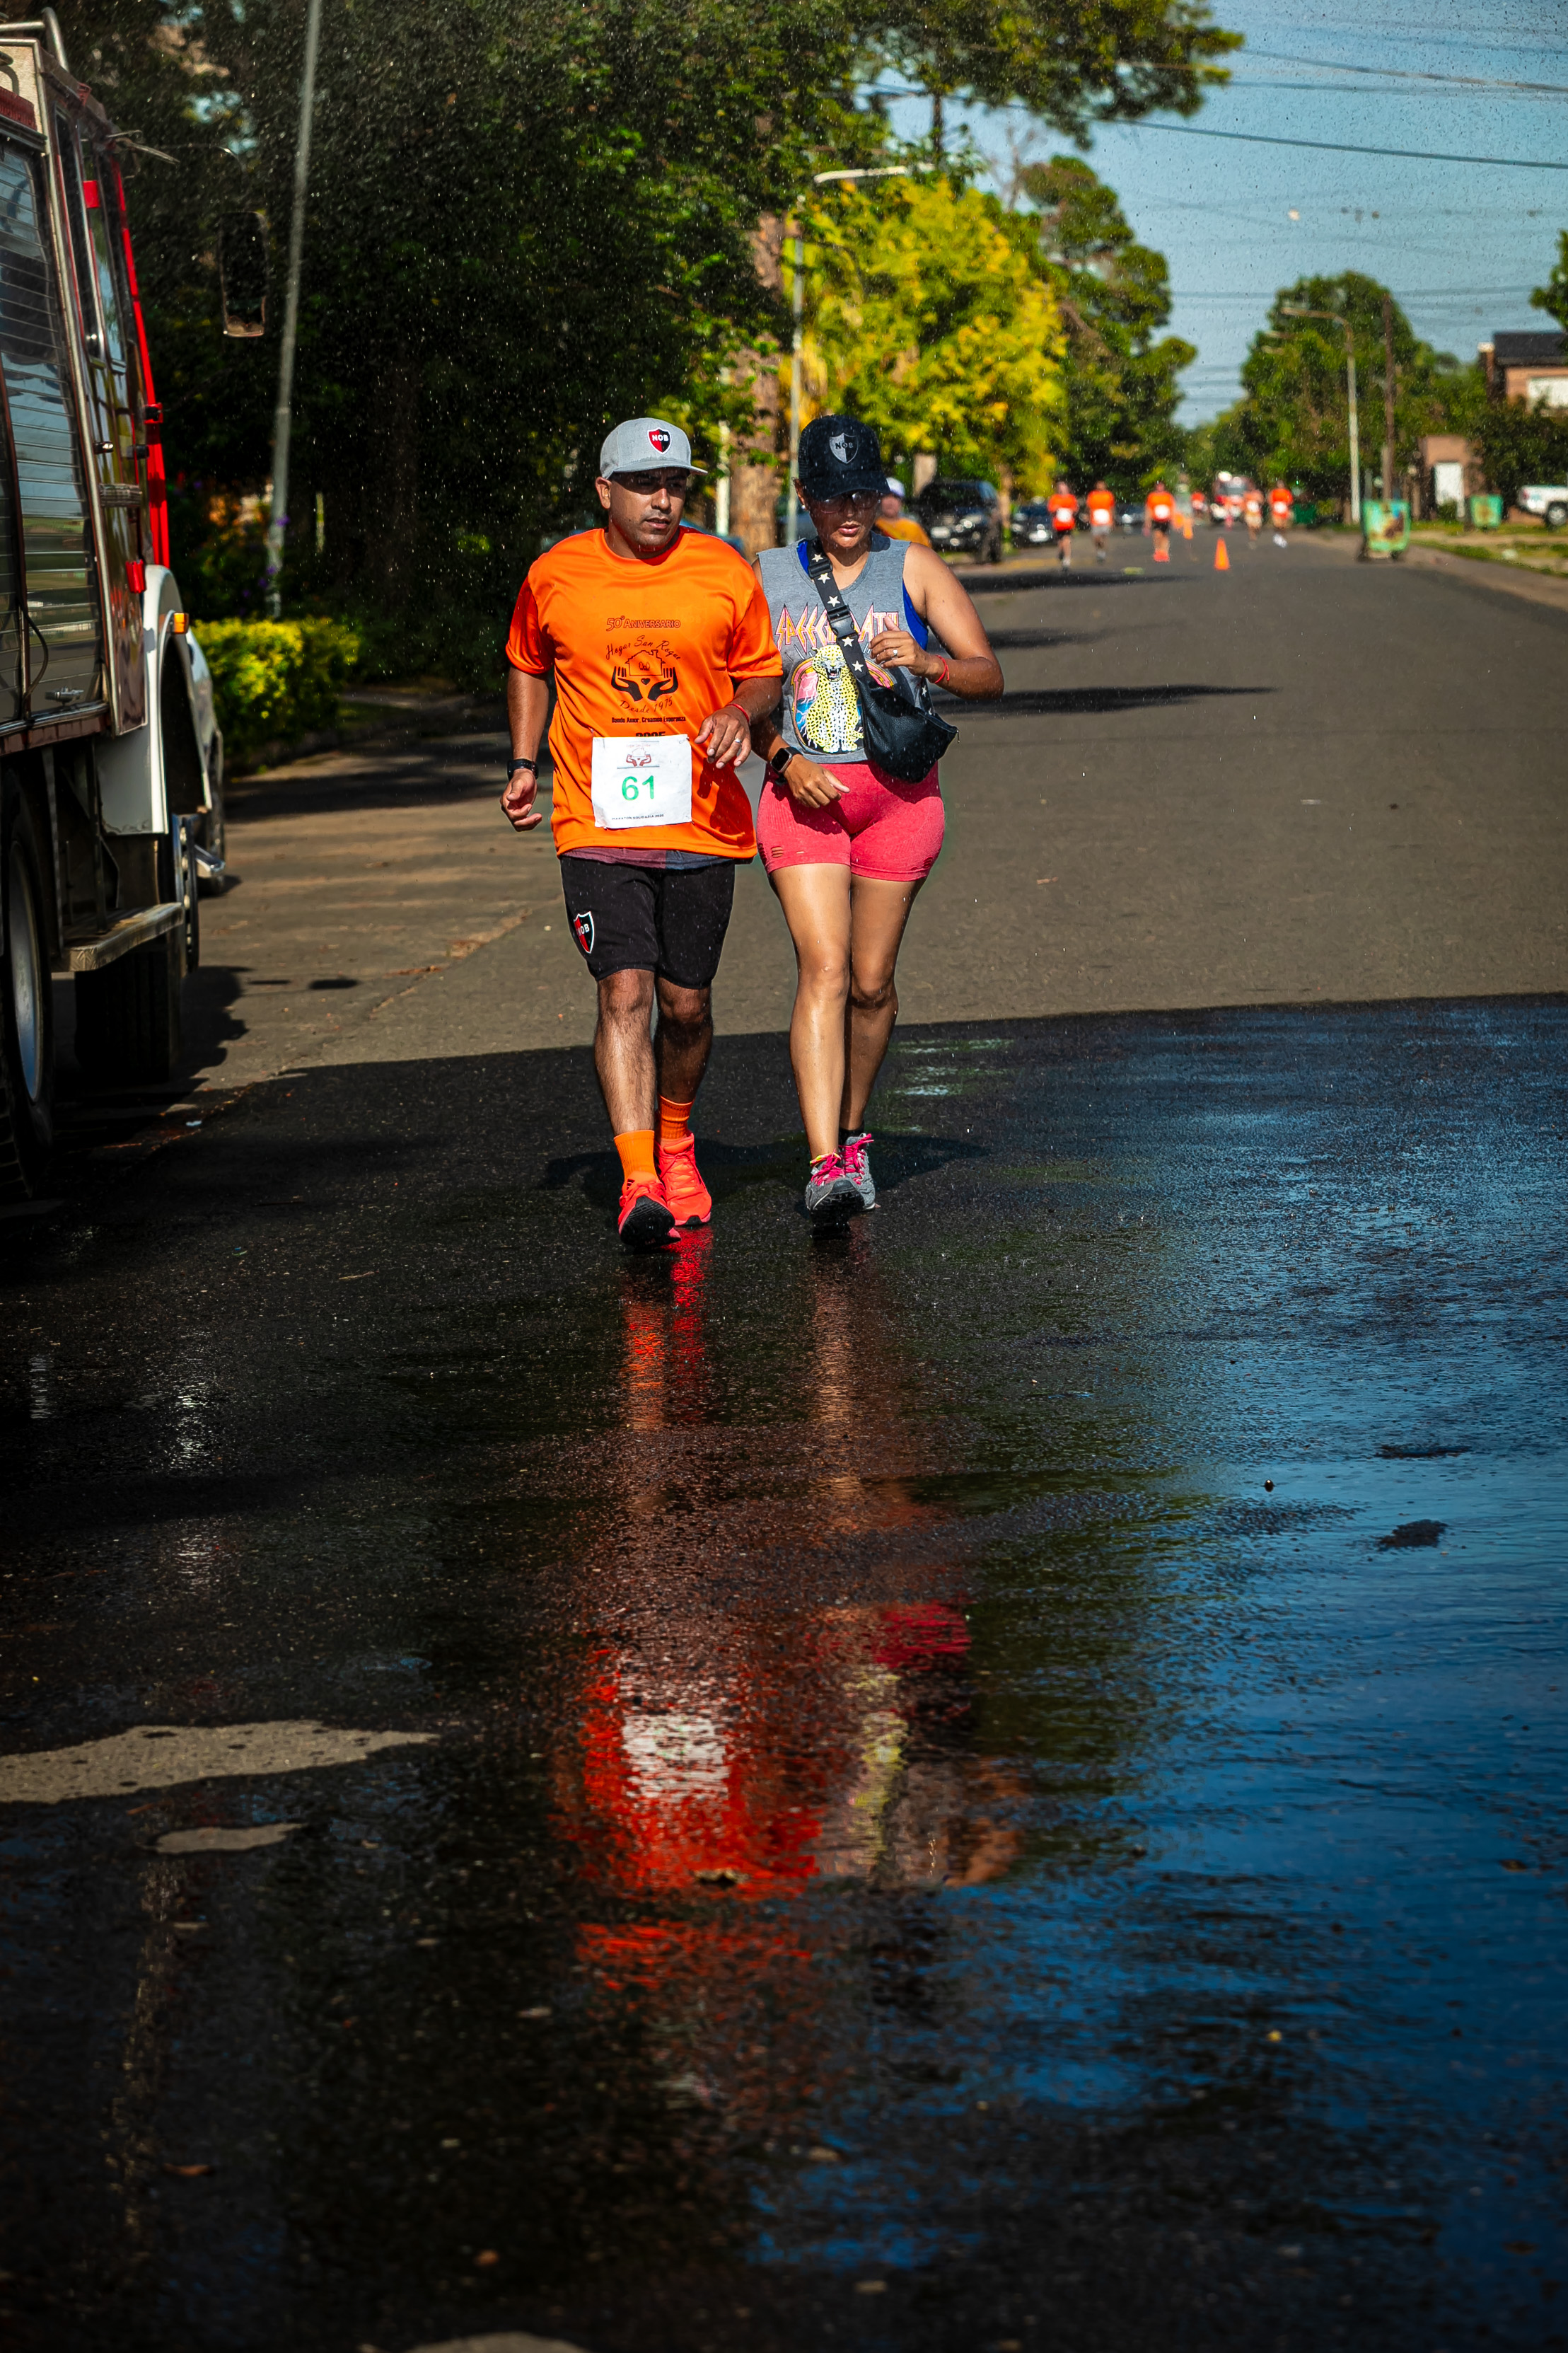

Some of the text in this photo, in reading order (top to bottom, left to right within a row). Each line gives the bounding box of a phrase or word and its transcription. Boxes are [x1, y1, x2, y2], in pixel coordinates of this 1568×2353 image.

[623, 618, 681, 629] ANIVERSARIO
[606, 635, 680, 660] Hogar San Roque
[620, 696, 673, 713] Desde 1975
[622, 775, 654, 801] 61
